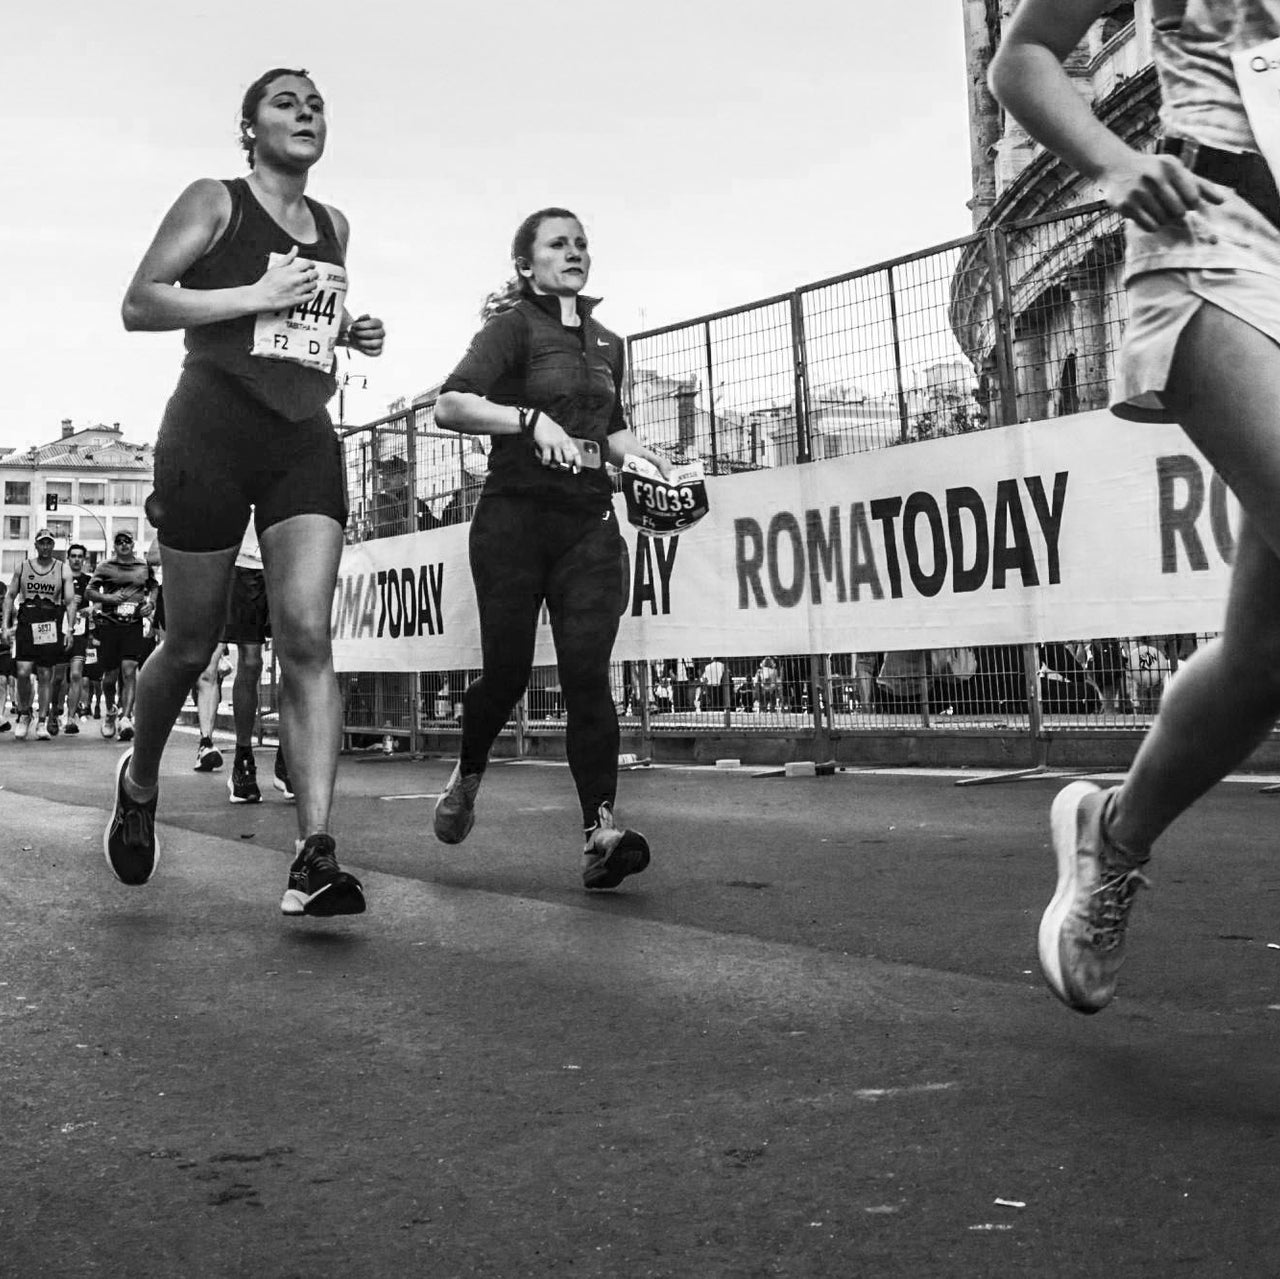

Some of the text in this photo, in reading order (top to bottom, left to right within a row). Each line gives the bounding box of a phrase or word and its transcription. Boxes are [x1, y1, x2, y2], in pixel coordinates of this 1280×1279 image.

[274, 334, 320, 355] F2 D
[632, 479, 696, 512] F3033
[642, 515, 687, 528] F4 C
[732, 470, 1070, 612] ROMATODAY
[27, 582, 55, 591] DOWN
